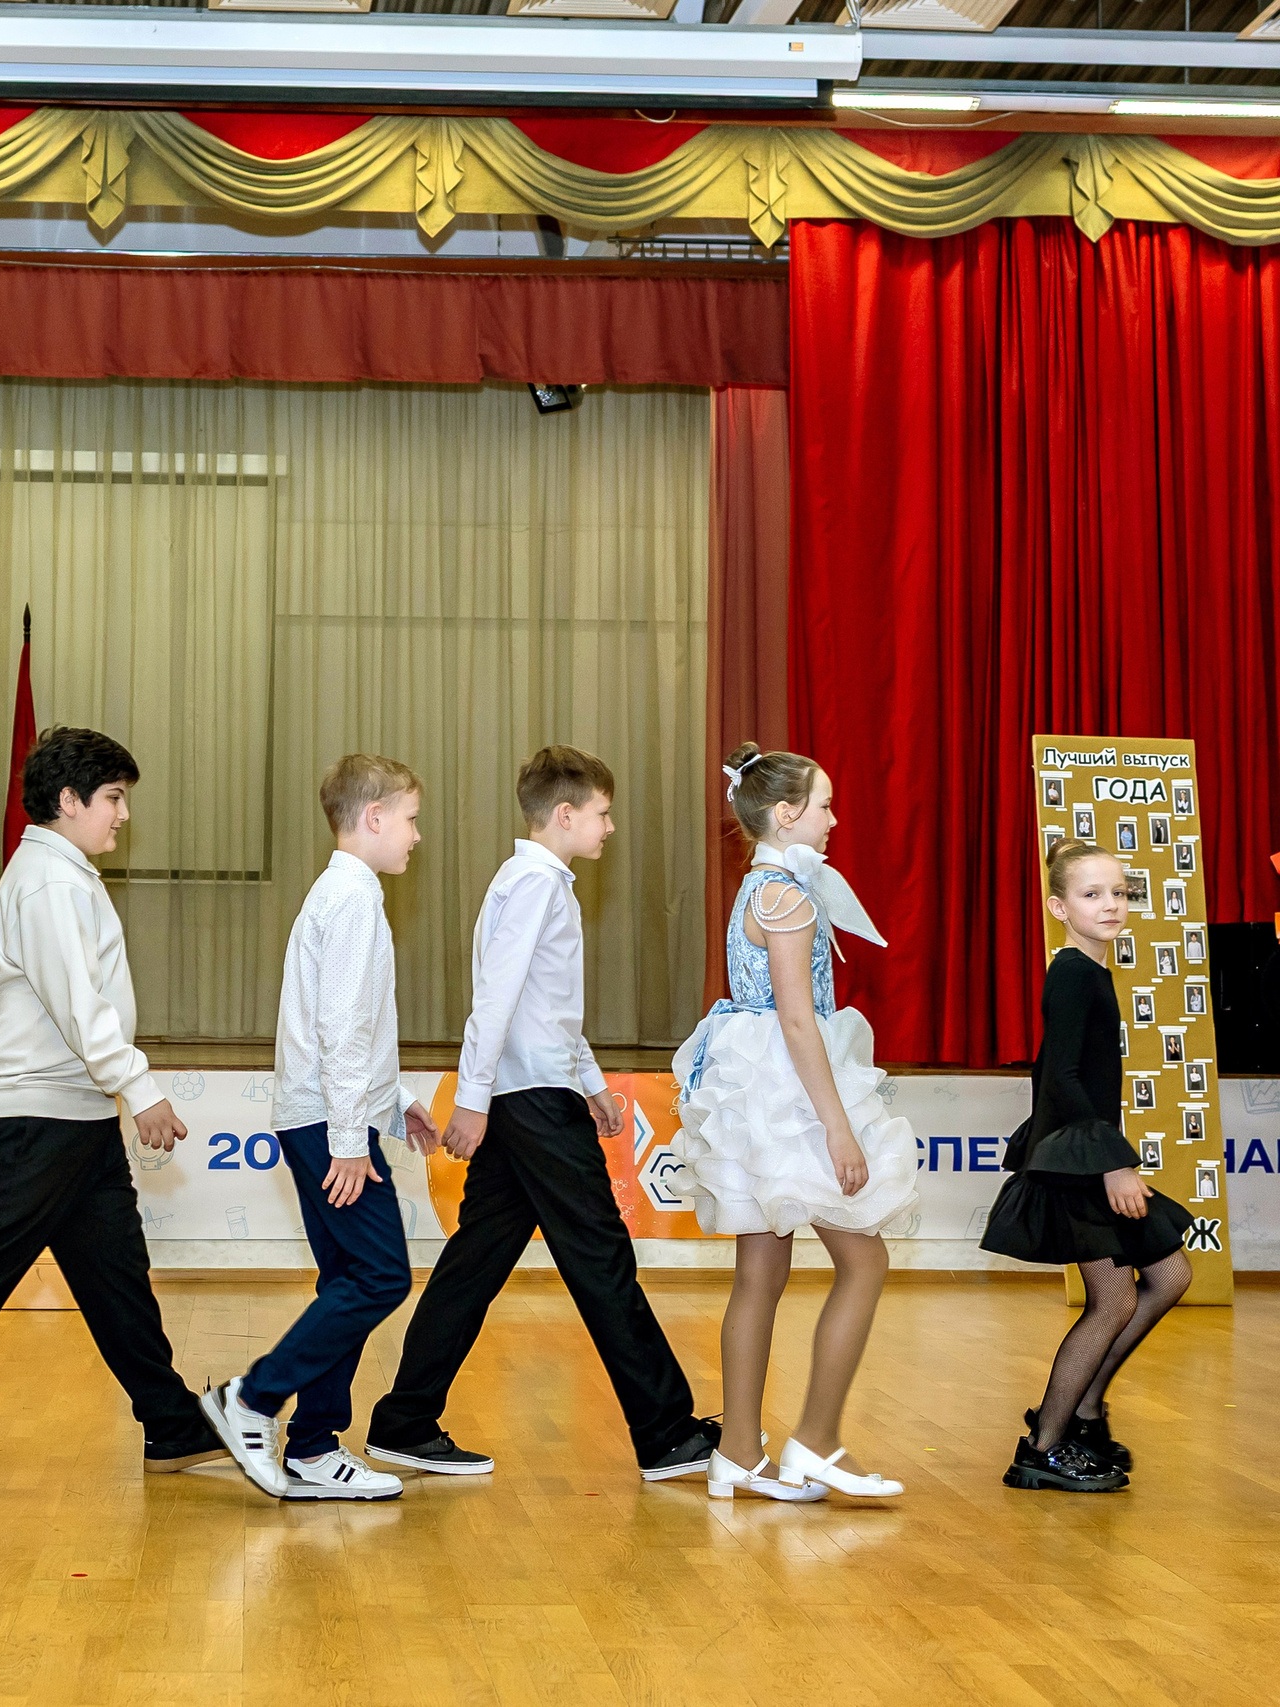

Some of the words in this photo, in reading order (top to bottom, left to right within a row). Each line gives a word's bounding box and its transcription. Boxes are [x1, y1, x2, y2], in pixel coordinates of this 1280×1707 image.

[1044, 749, 1116, 768] Лучший
[1123, 754, 1189, 771] выпуск
[1095, 778, 1166, 804] ГОДА
[207, 1132, 290, 1170] 20
[915, 1136, 1010, 1172] ПЕ
[1187, 1218, 1220, 1250] Ж
